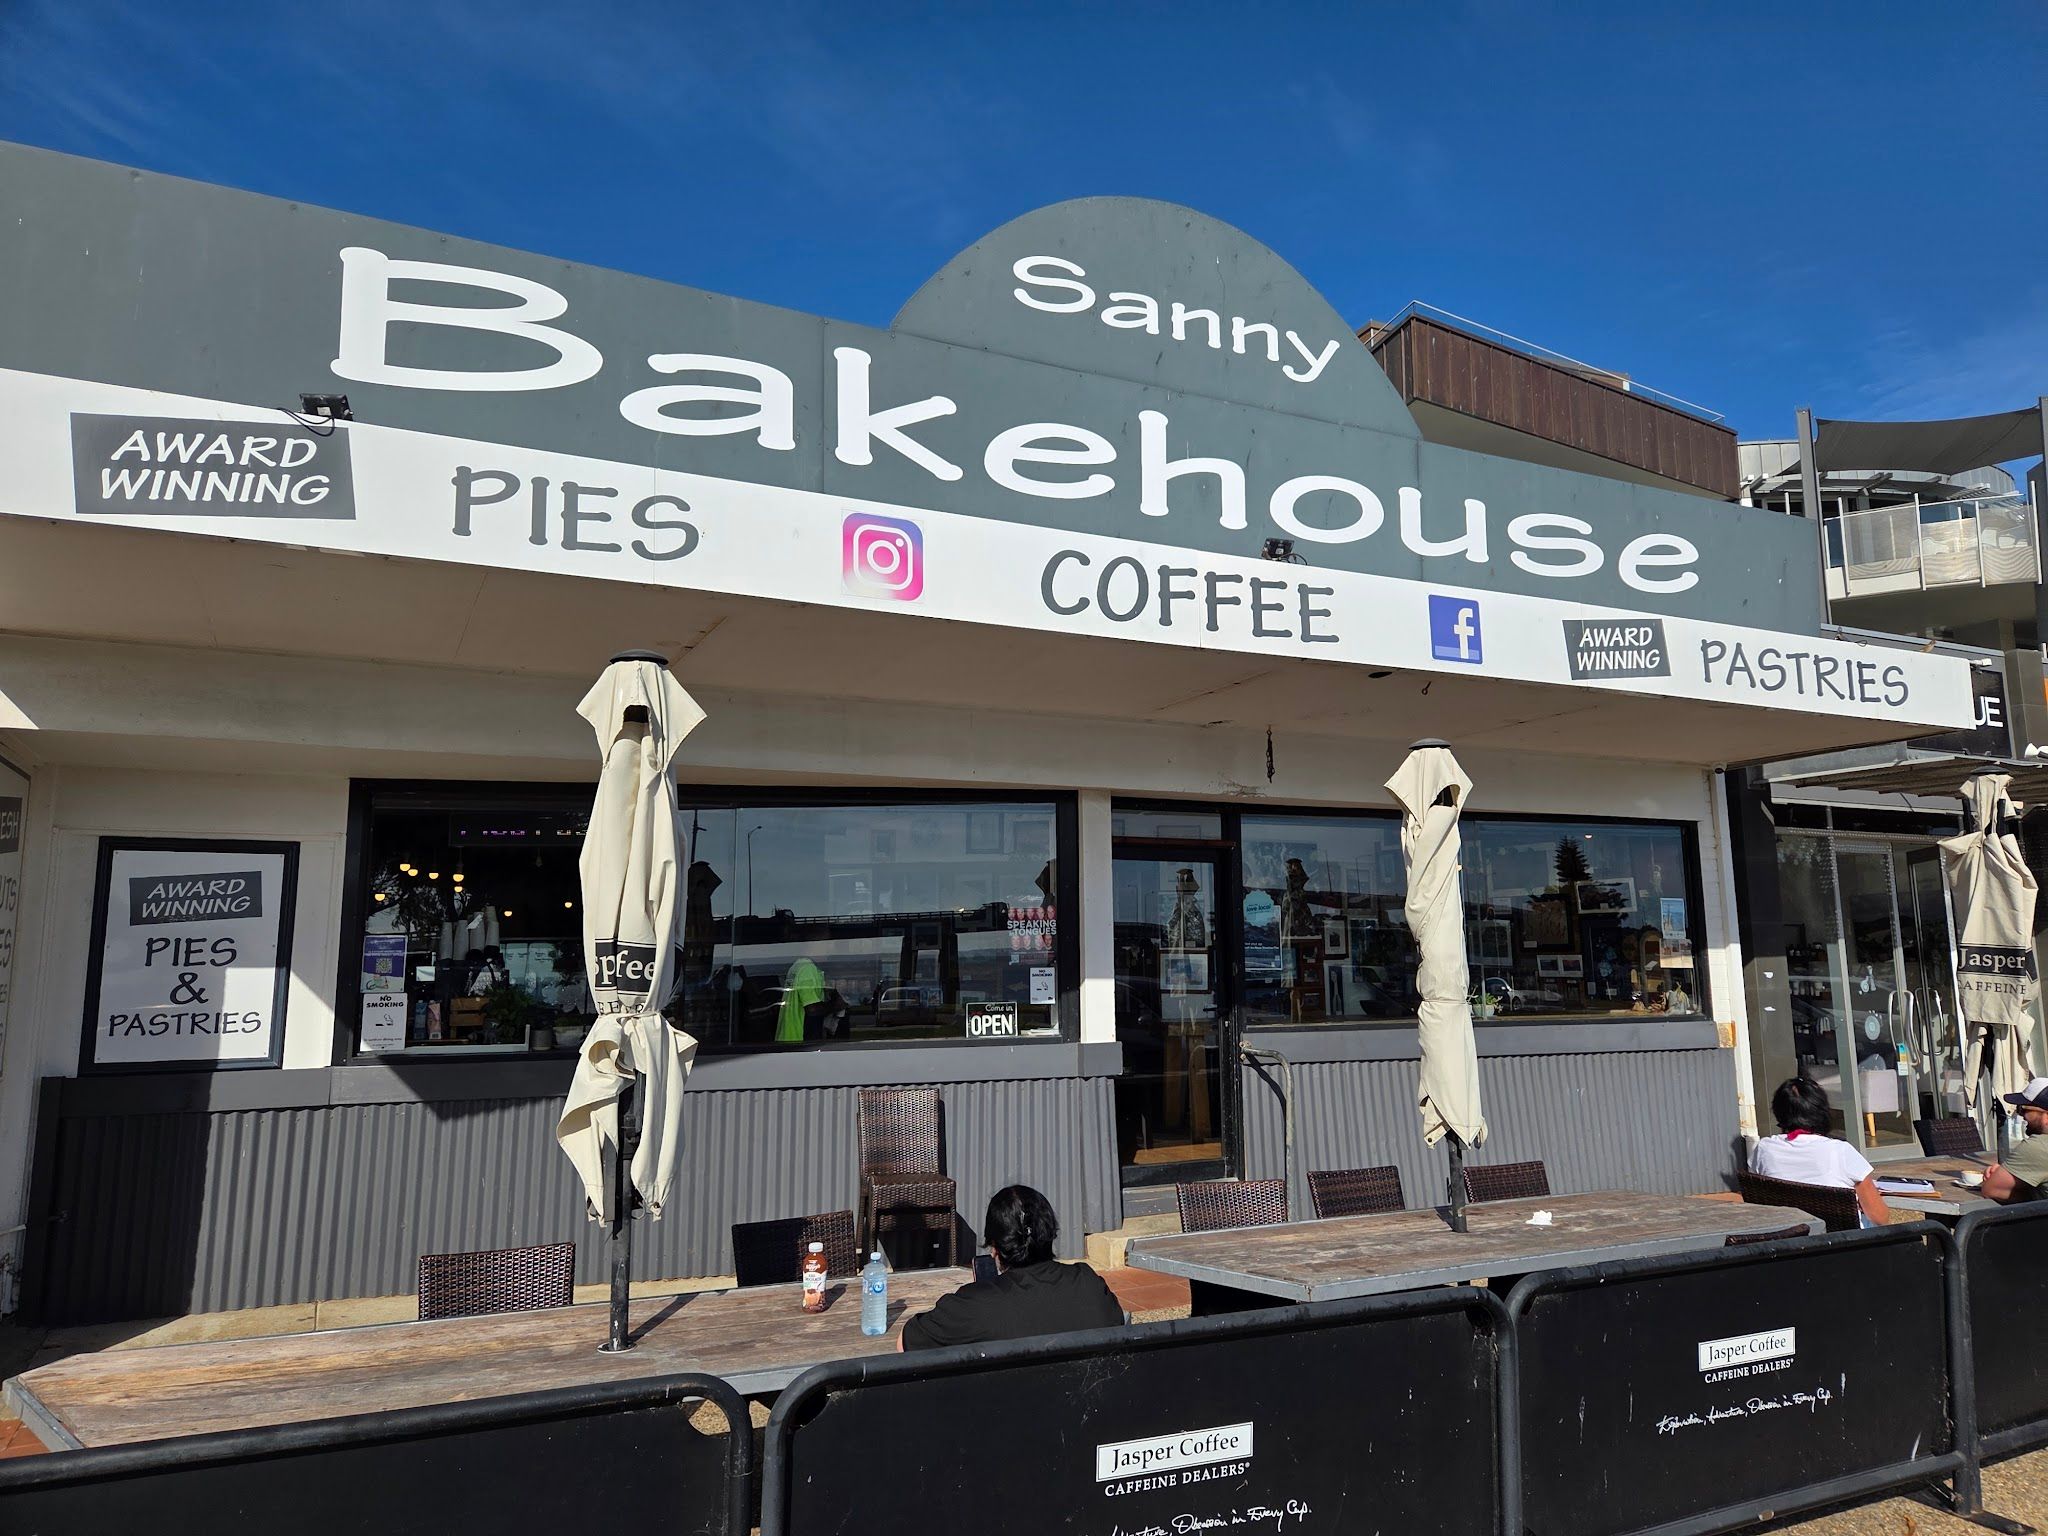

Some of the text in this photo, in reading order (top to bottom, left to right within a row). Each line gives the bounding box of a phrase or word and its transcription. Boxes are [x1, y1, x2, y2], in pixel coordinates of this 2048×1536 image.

[1013, 256, 1341, 383] Sanny
[331, 246, 1699, 594] Bakehouse
[111, 430, 317, 468] AWARD
[102, 468, 330, 505] WINNING
[452, 465, 700, 561] PIES
[1041, 549, 1340, 643] COFFEE
[1579, 626, 1654, 648] AWARD
[1576, 649, 1661, 672] WINNING
[1701, 639, 1910, 707] PASTRIES
[147, 878, 246, 900] AWARD
[141, 896, 252, 919] WINNING
[1007, 919, 1057, 929] SPEAKING
[1012, 927, 1057, 937] TONGUES
[144, 937, 238, 967] PIES
[1958, 948, 2026, 973] Jasper
[169, 972, 209, 1005] &
[380, 994, 392, 1002] NO
[985, 1003, 1004, 1012] Come
[108, 1012, 262, 1037] PASTRIES
[971, 1013, 1014, 1036] OPEN
[1708, 1336, 1787, 1364] Jasper Coffee
[1704, 1367, 1750, 1384] CAFFEINE
[1112, 1433, 1239, 1473] Jasper Coffee
[1104, 1474, 1177, 1497] CAFFEINE
[1231, 1508, 1247, 1525] in
[1246, 1506, 1284, 1533] Every
